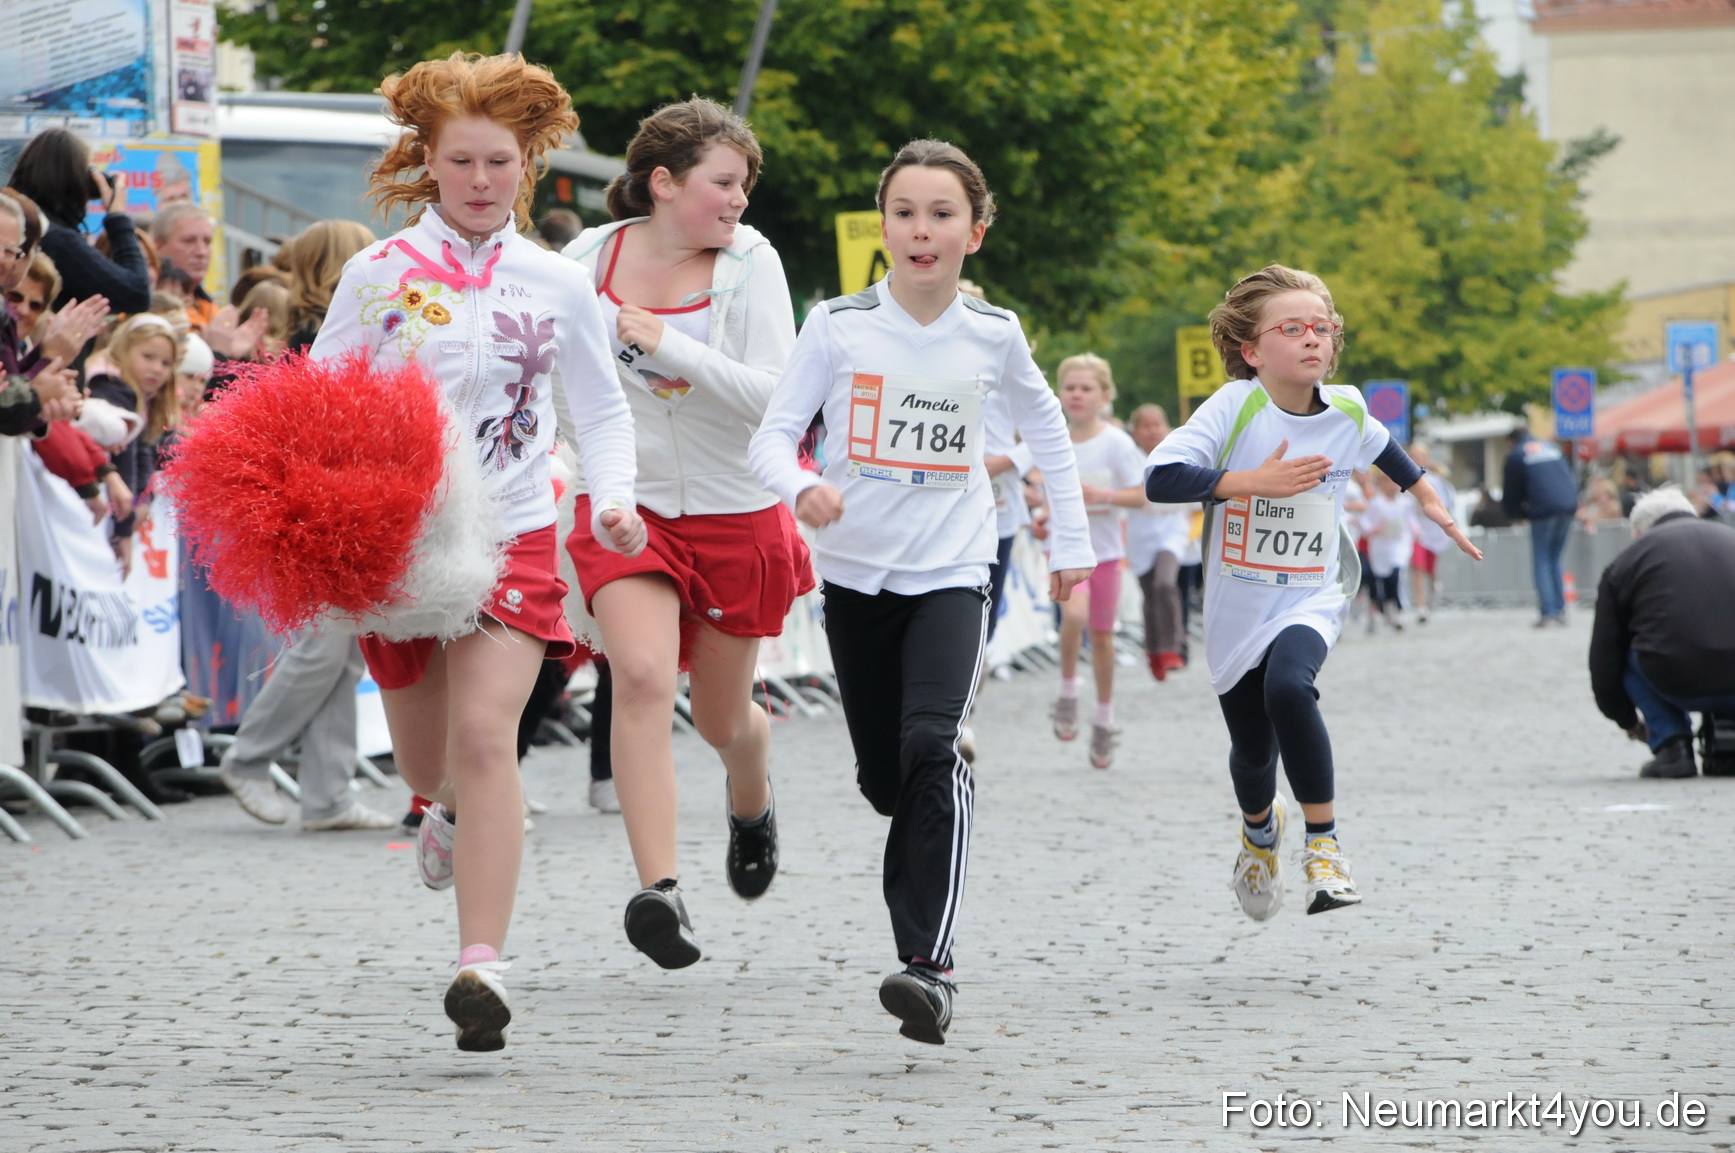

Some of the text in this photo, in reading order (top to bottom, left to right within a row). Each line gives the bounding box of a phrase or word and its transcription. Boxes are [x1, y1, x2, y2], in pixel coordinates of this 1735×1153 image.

[1191, 348, 1212, 379] B
[888, 420, 966, 453] 7184
[926, 472, 969, 482] PFLEIDERER
[1255, 499, 1294, 519] Clara
[1228, 522, 1241, 536] B3
[1255, 528, 1323, 557] 7074
[1290, 573, 1324, 581] PFLEIDERER
